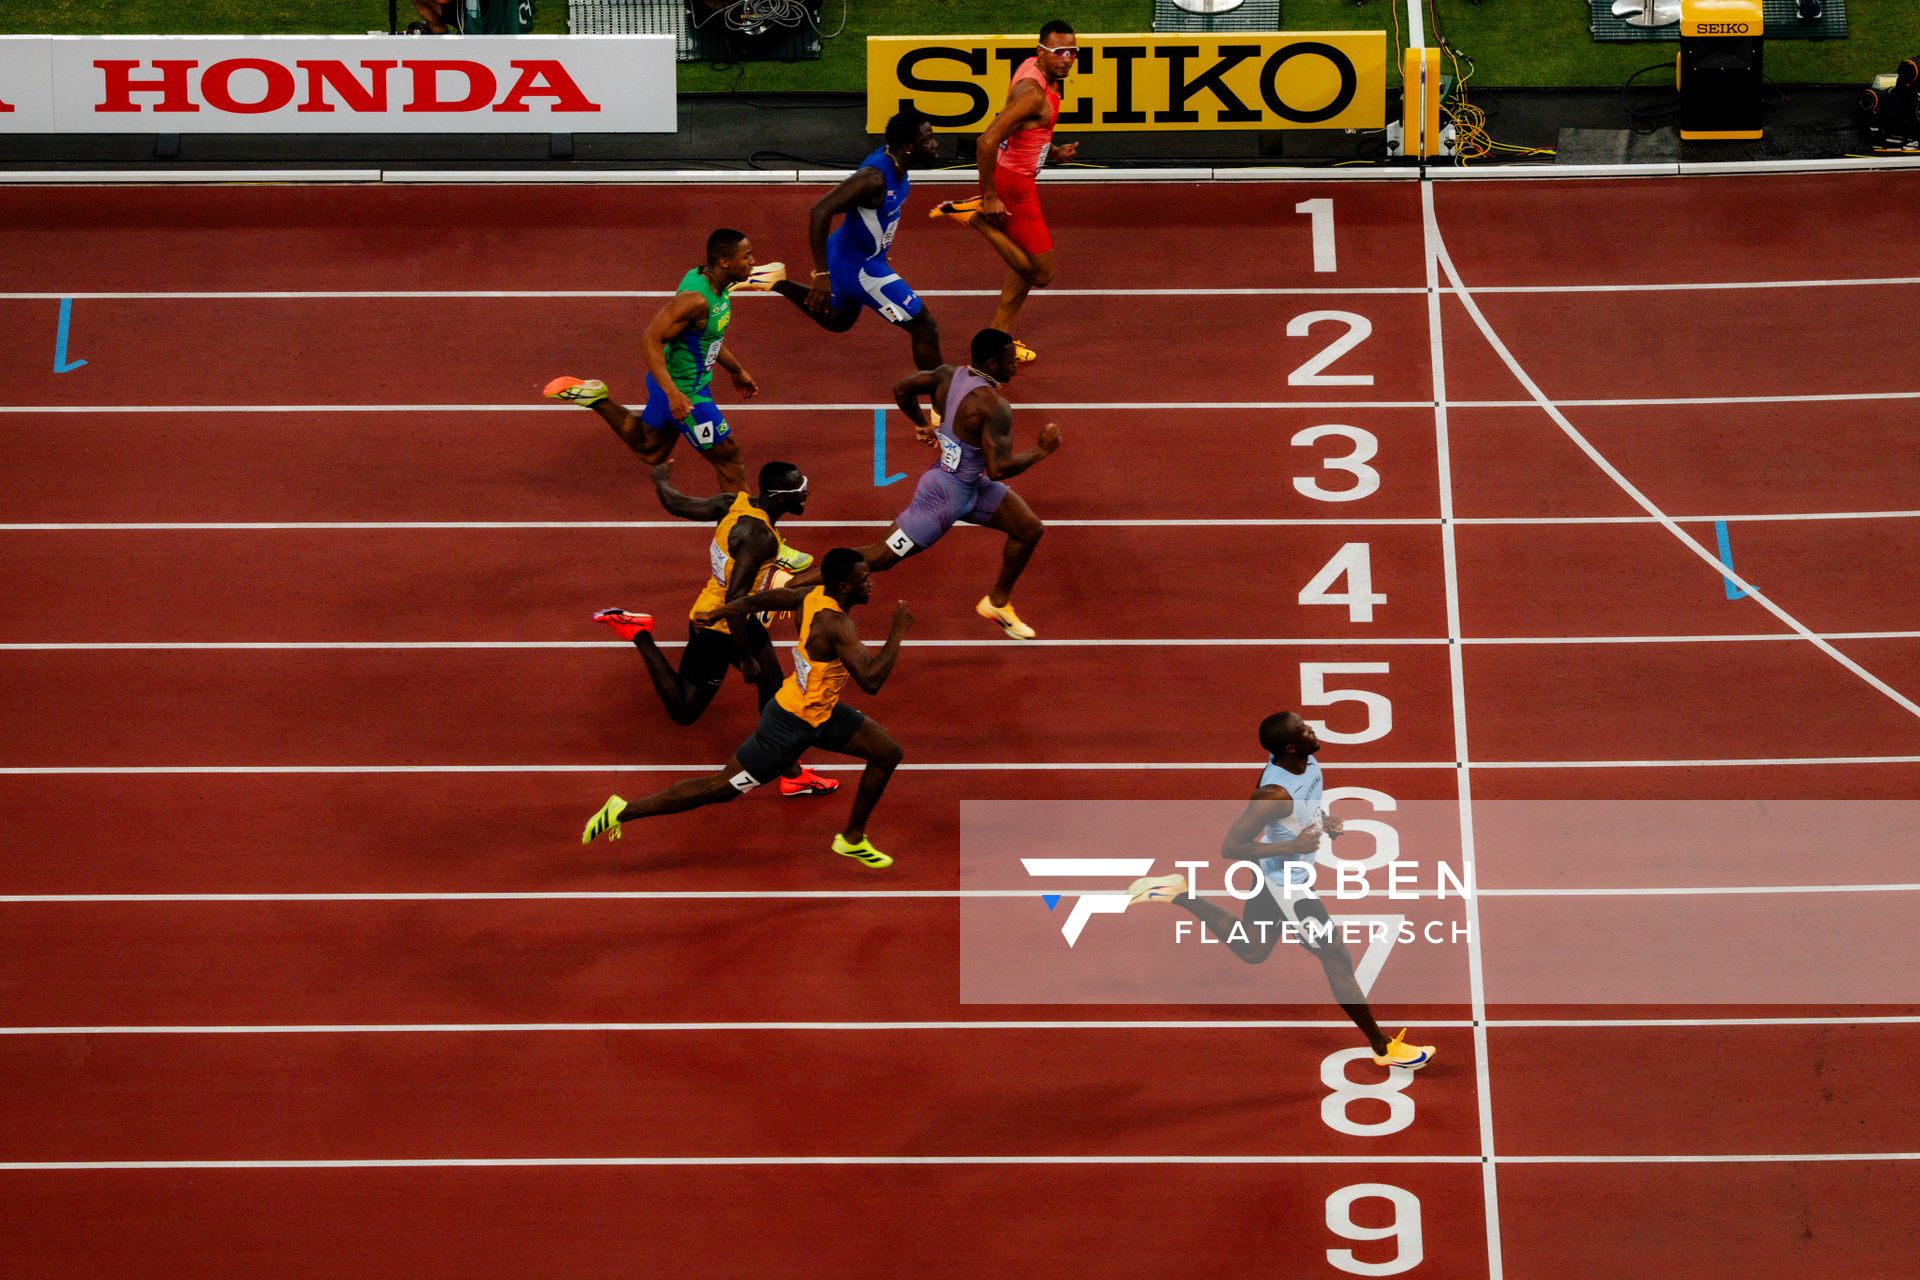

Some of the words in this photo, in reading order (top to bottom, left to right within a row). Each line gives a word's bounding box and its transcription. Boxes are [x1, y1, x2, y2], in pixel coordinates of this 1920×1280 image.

[1697, 23, 1749, 34] SEIKO
[92, 57, 601, 114] HONDA
[896, 41, 1358, 128] SEIKO
[1295, 198, 1337, 273] 1
[1286, 310, 1374, 386] 2
[702, 426, 711, 438] 4
[1291, 424, 1381, 502] 3
[893, 537, 907, 550] 5
[1298, 542, 1388, 623] 4
[1299, 662, 1394, 745] 5
[736, 776, 753, 786] 7
[1317, 786, 1401, 871] 6
[1332, 913, 1405, 999] 7
[1320, 1046, 1415, 1137] 8
[1325, 1182, 1424, 1277] 9
